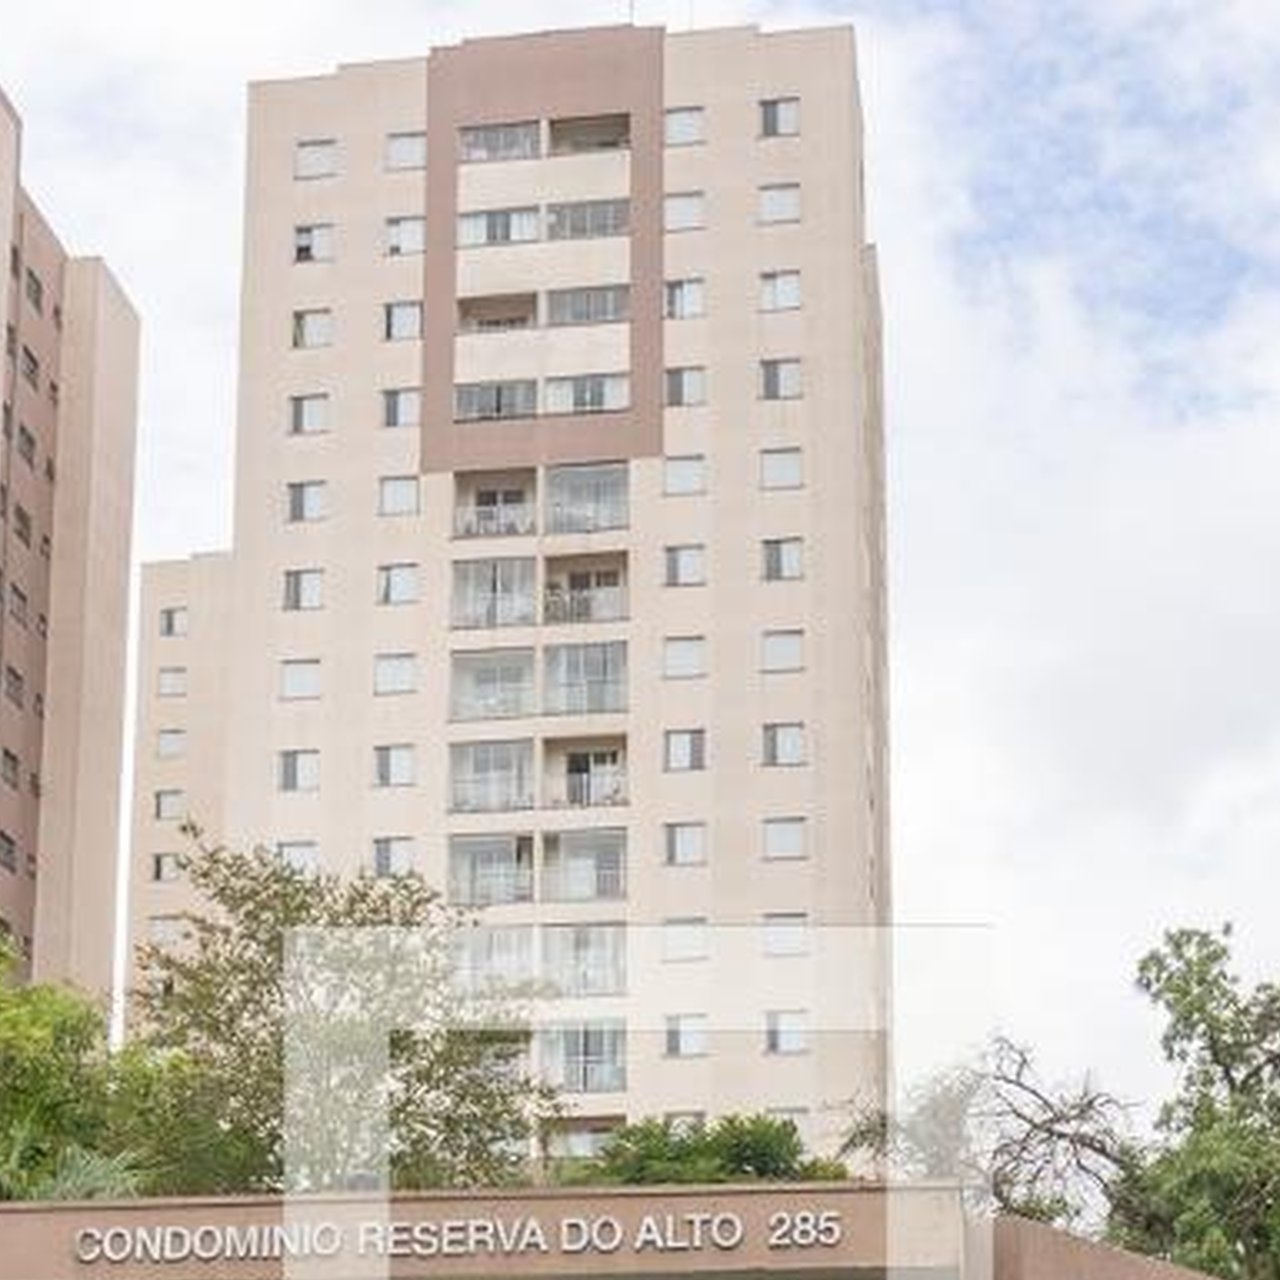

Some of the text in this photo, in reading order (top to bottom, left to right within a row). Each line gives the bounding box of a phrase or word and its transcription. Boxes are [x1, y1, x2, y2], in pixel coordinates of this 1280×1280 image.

[75, 1211, 842, 1262] CONDOMINIO RESERVA DO ALTO 285
